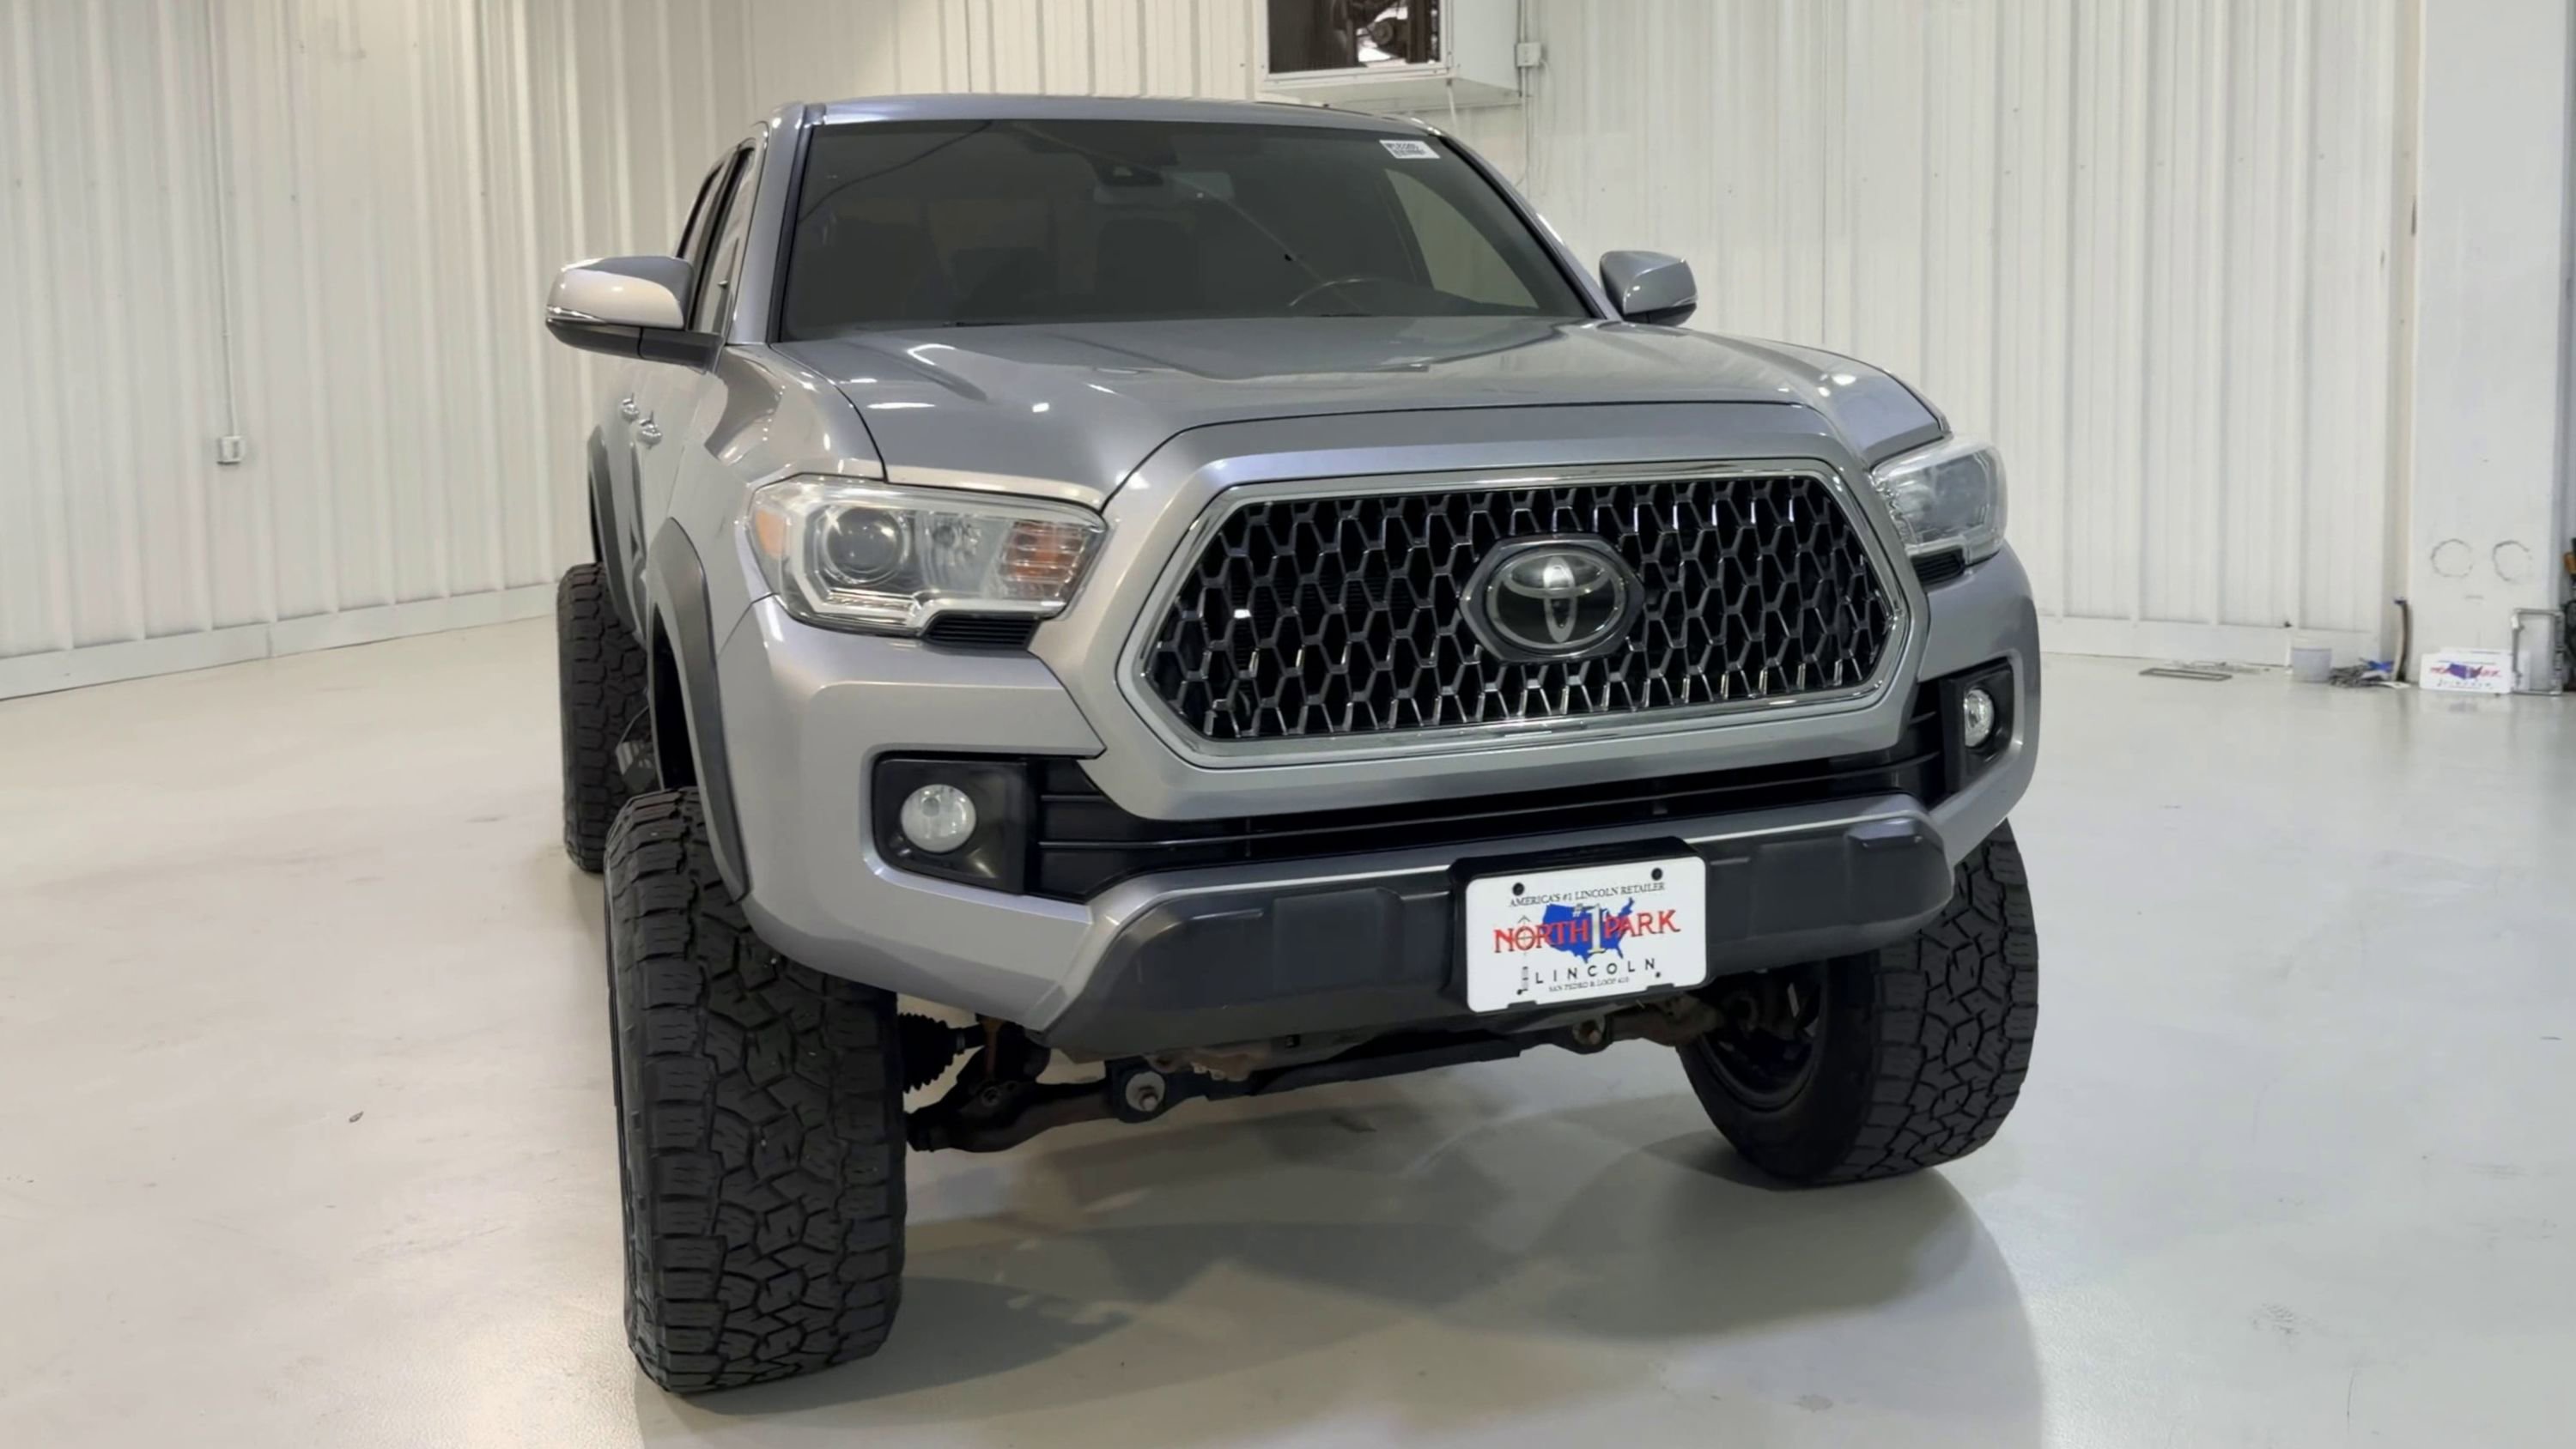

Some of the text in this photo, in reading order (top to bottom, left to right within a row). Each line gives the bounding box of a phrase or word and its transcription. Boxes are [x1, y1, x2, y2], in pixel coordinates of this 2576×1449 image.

[1510, 882, 1666, 907] AMERICA'S #1 LINCOLN RETAILER
[1493, 909, 1681, 954] NORTH PARK
[1535, 958, 1656, 985] LINCOLN
